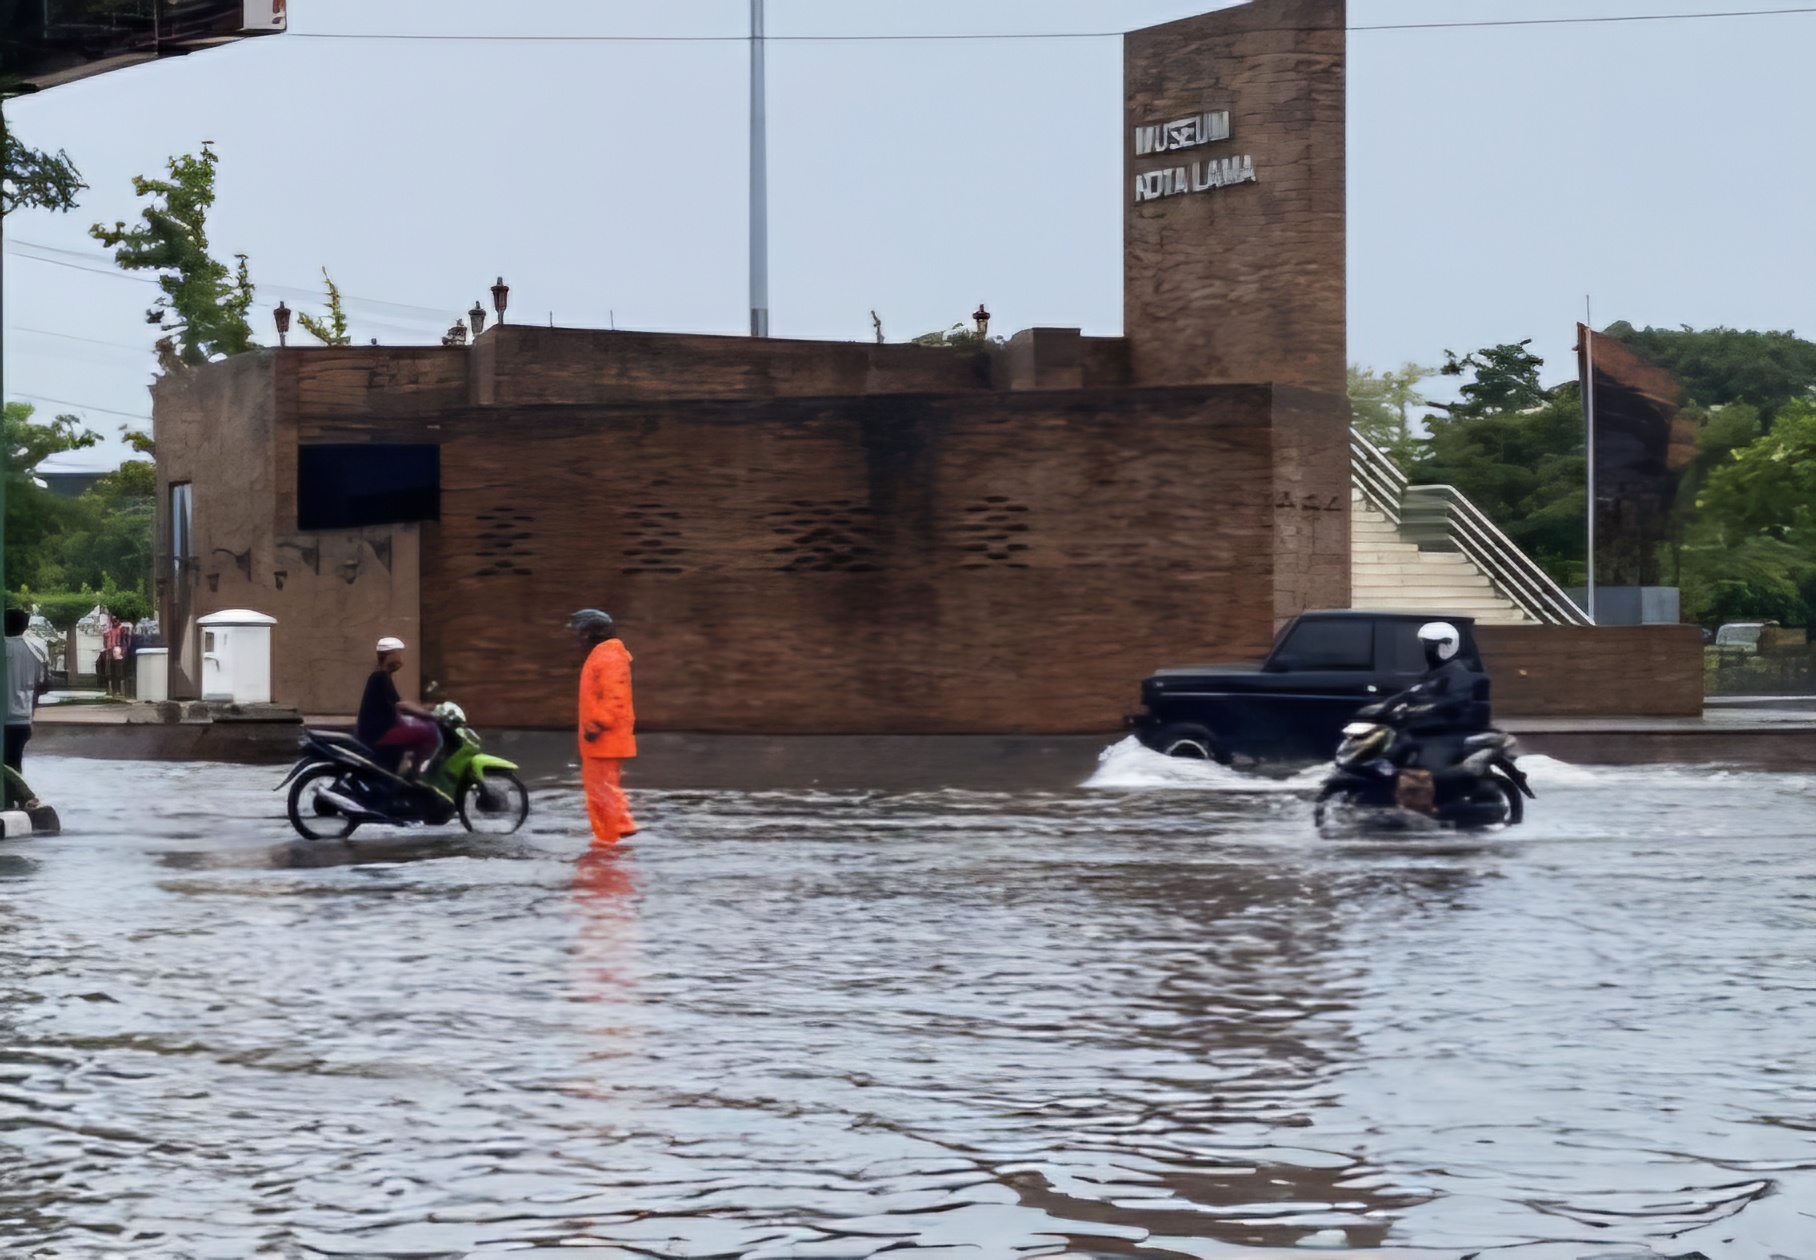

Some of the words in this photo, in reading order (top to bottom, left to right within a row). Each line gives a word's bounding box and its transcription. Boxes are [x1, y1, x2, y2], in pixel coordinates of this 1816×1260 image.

[1135, 110, 1230, 156] MUSEUM
[1135, 167, 1188, 202] KOTA
[1191, 154, 1257, 192] LAMA
